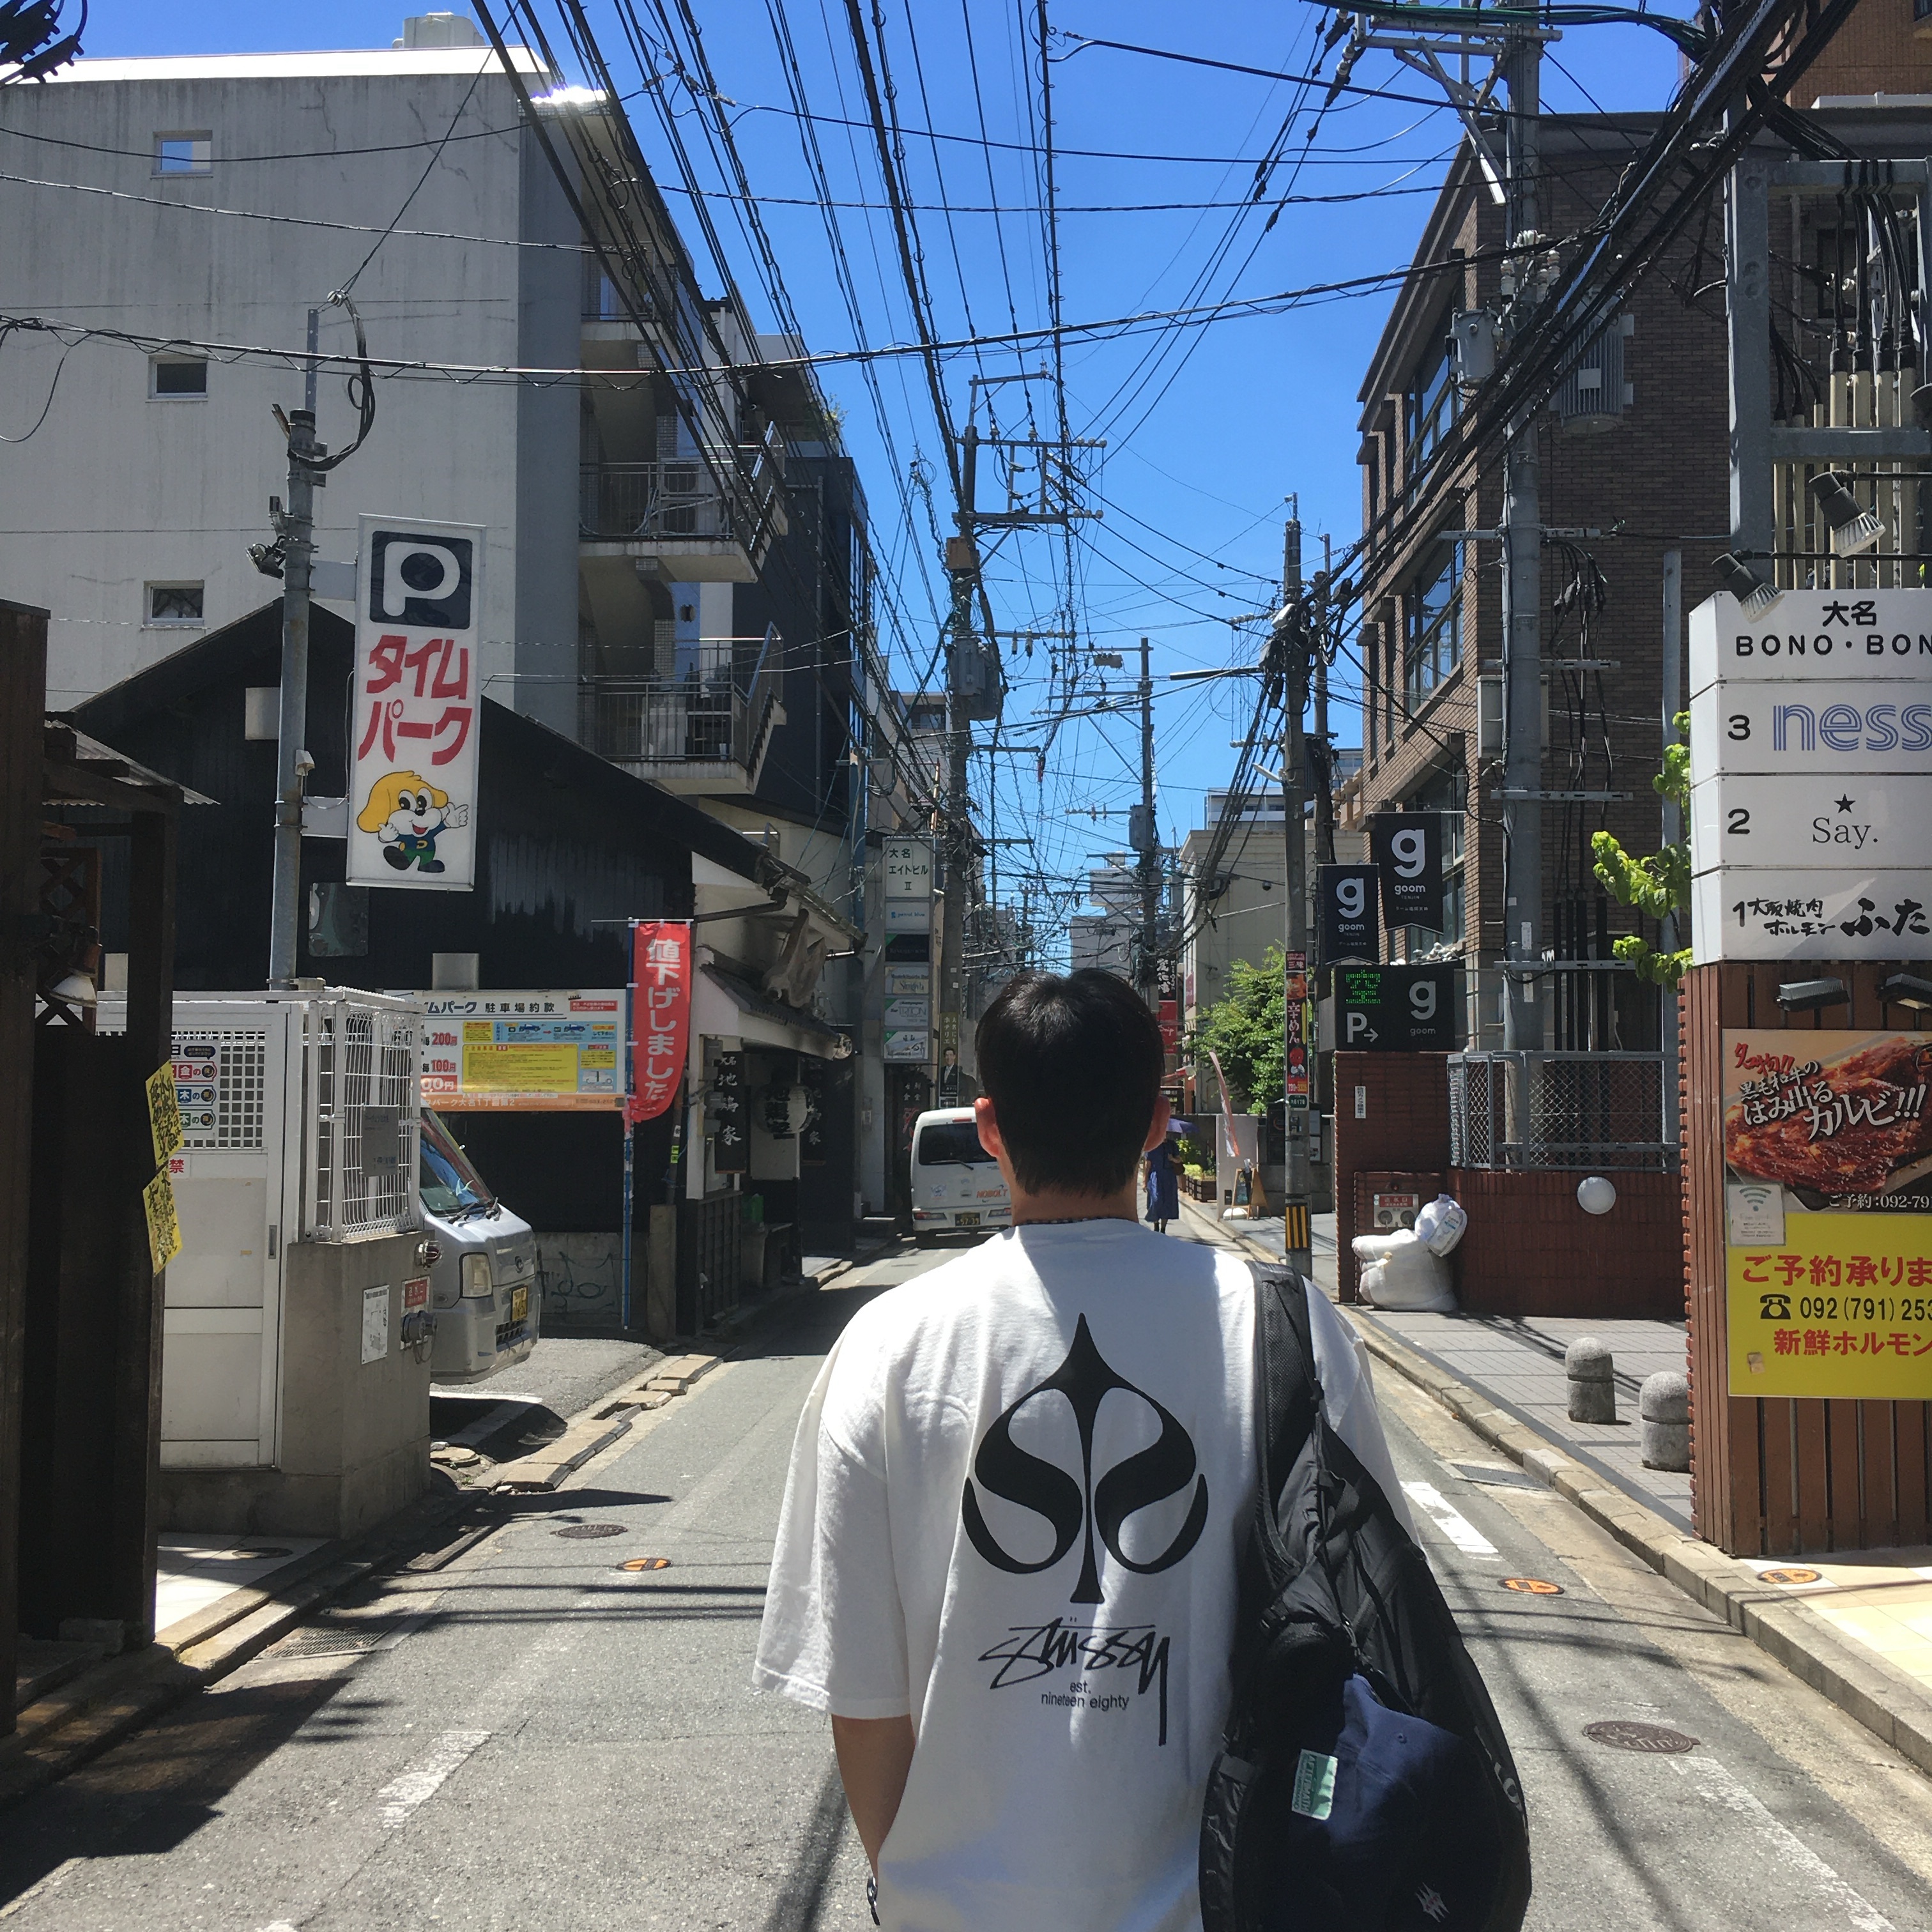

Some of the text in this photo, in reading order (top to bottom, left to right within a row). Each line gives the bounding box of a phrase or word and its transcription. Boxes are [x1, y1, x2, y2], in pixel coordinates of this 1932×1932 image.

[383, 541, 460, 616] P
[1822, 601, 1876, 626] 大名
[366, 635, 468, 700] タイム
[358, 698, 472, 765] パーク
[1728, 704, 1932, 751] 3 ness
[1728, 808, 1878, 850] 2 Say.
[889, 848, 910, 859] 大名
[1392, 829, 1425, 878] g
[889, 865, 928, 875] エイトビル
[1337, 878, 1365, 919] g
[1395, 885, 1426, 895] goom
[1748, 898, 1823, 917] 大阪焼肉
[1841, 898, 1930, 936] ふた
[1338, 924, 1365, 932] goom
[1765, 920, 1836, 936] ホルモン
[424, 1000, 555, 1013] ムパーク 駐車場約款
[1409, 981, 1436, 1020] g
[646, 939, 681, 1100] 値下げしました
[1288, 1002, 1301, 1043] 辛めん
[1347, 1013, 1367, 1043] P
[1410, 1027, 1436, 1036] goom
[432, 1032, 457, 1046] 200円
[431, 1059, 457, 1073] 100円
[1740, 1061, 1818, 1101] 黒毛和牛の
[1743, 1080, 1833, 1125] はみ出る
[1803, 1084, 1927, 1141] カルビ!!!
[1742, 1254, 1932, 1287] ご予約承りま
[1774, 1328, 1932, 1357] 新鮮ホルモン
[1041, 1691, 1130, 1712] nineteen eighty
[1070, 1681, 1091, 1694] est.
